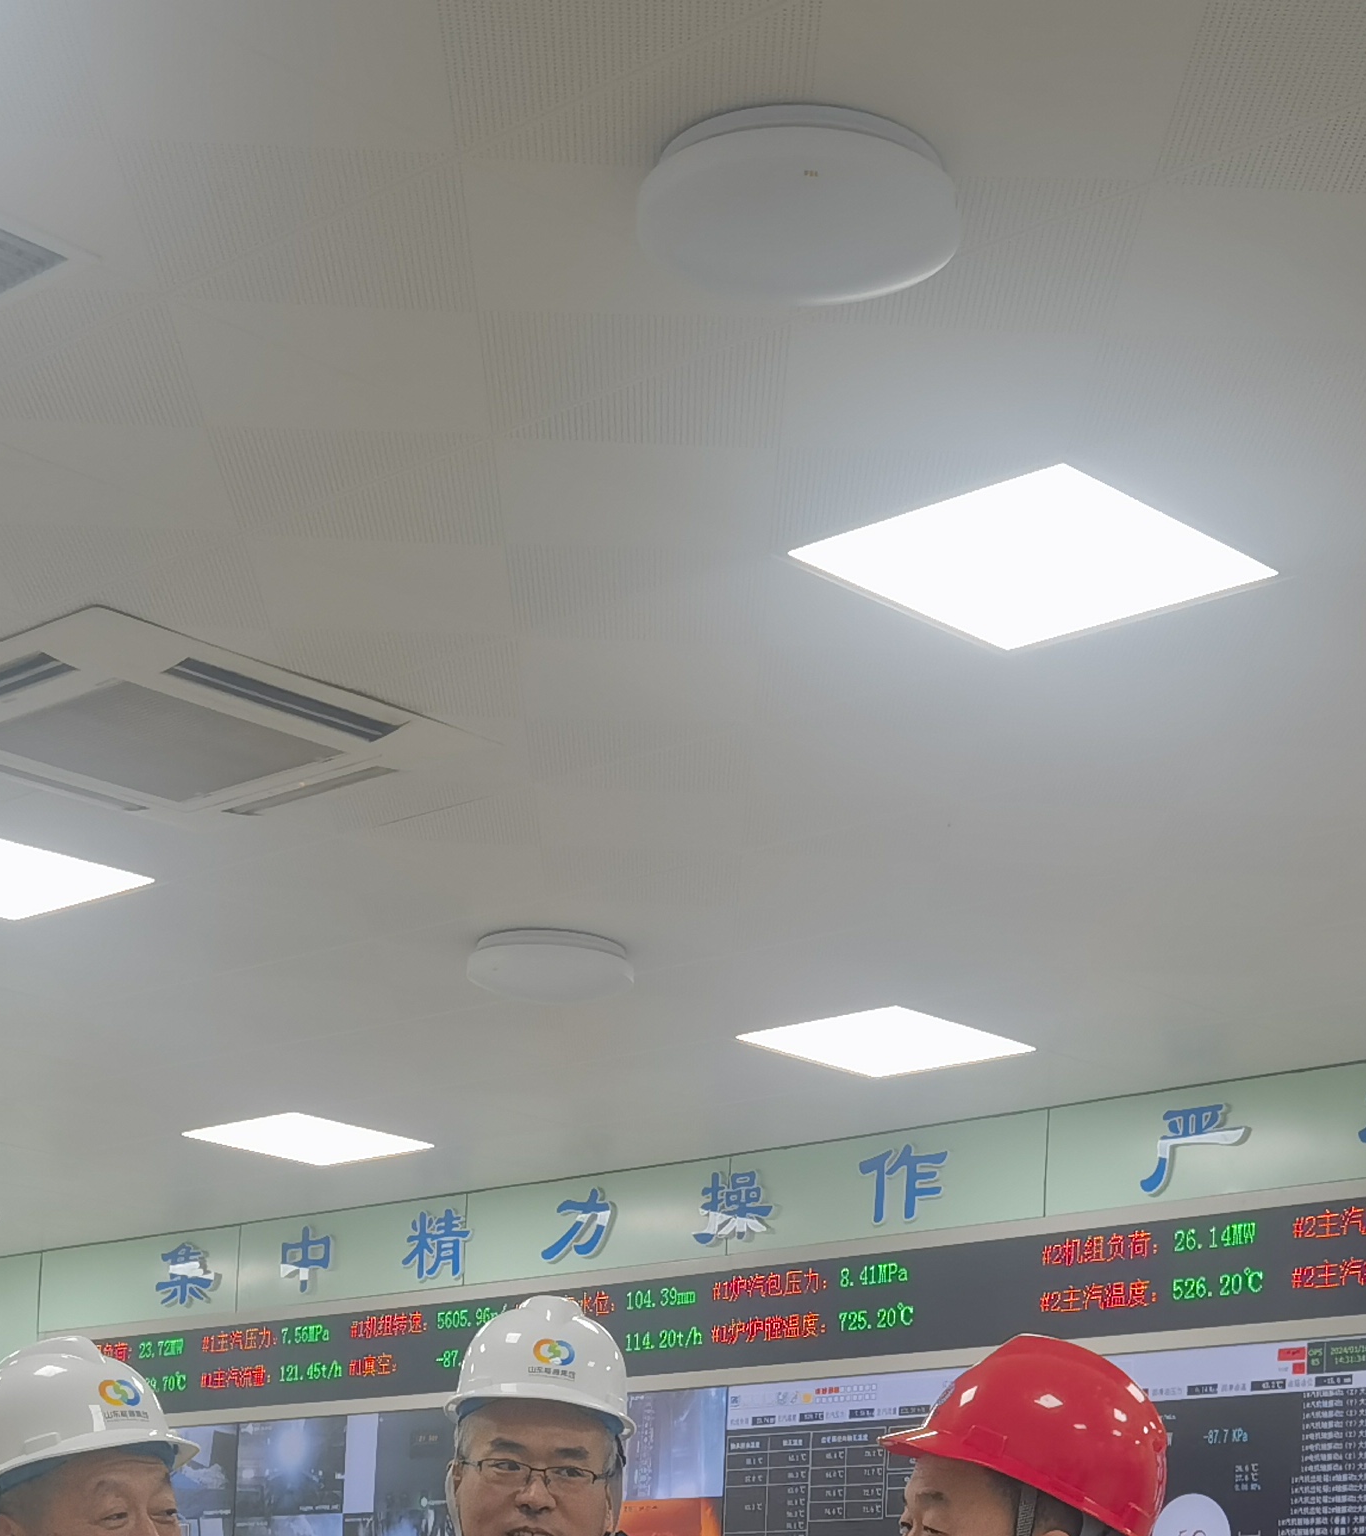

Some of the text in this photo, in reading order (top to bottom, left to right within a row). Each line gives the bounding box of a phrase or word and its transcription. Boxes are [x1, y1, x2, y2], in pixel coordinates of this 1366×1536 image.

[1041, 1222, 1256, 1266] #2机组负荷： 26.14MW
[712, 1263, 908, 1302] #1炉汽包压力： 8.41MPa
[1040, 1267, 1263, 1313] #2主汽温度： 526.20℃
[626, 1287, 696, 1311] 104.39mm
[350, 1311, 427, 1338] #1机组转速：
[711, 1302, 913, 1345] #1炉炉膛温度： 725.20℃
[139, 1338, 184, 1359] 23.72MW
[202, 1324, 329, 1353] #1主汽压力： 7.56MPa
[625, 1326, 702, 1352] 114.20t/h
[200, 1360, 343, 1390] #1主汽流量： 121.45t/h
[349, 1350, 462, 1377] #1真空： -87.
[1202, 1429, 1230, 1445] -87.7
[1232, 1427, 1249, 1443] KPa
